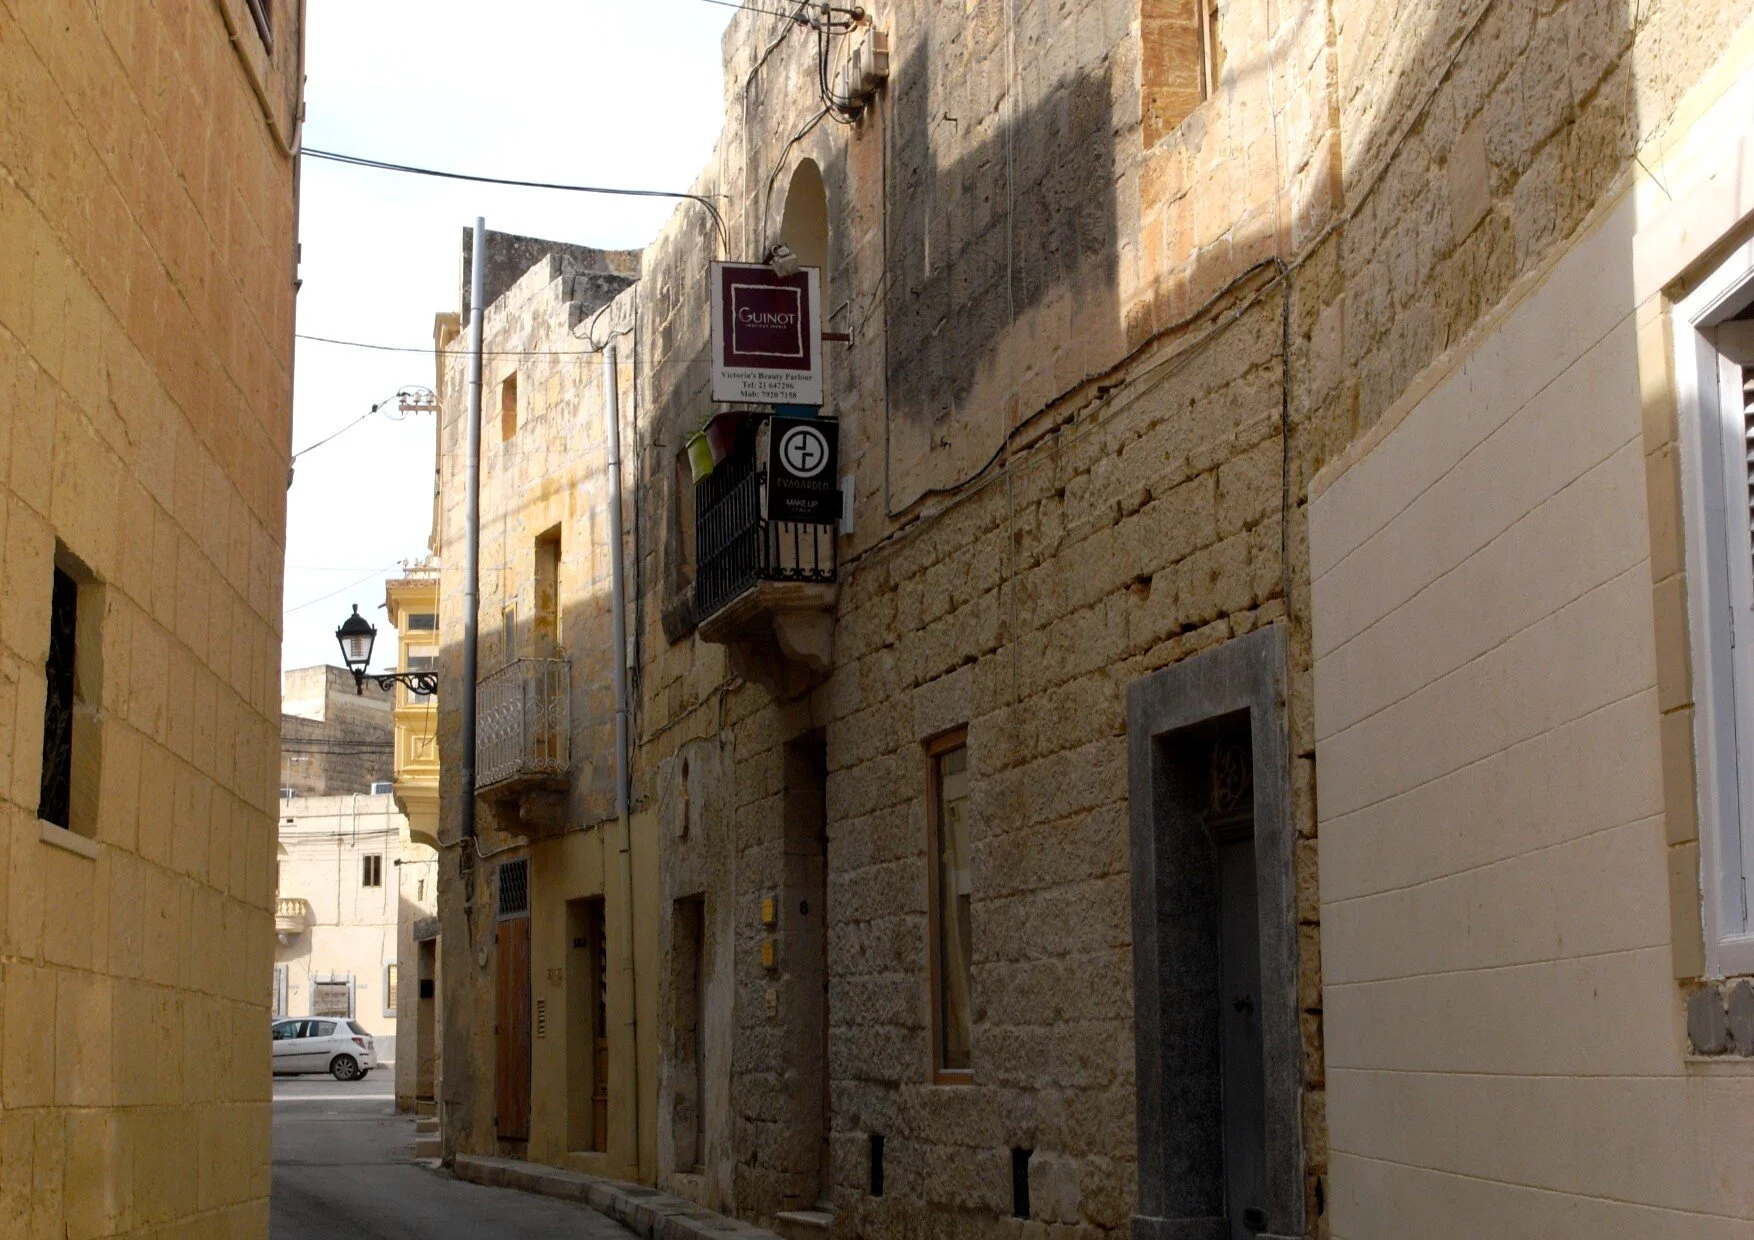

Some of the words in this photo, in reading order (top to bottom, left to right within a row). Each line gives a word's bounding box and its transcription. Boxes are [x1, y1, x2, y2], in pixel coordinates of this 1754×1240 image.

[739, 307, 796, 324] GUINOT
[721, 371, 756, 380] Victoria's
[758, 372, 783, 381] Beauty
[785, 373, 813, 381] Parlour
[743, 381, 756, 389] Tel:
[768, 382, 794, 390] 647296
[740, 390, 759, 398] Mob:
[780, 391, 797, 399] 7158
[786, 499, 807, 508] MAKE
